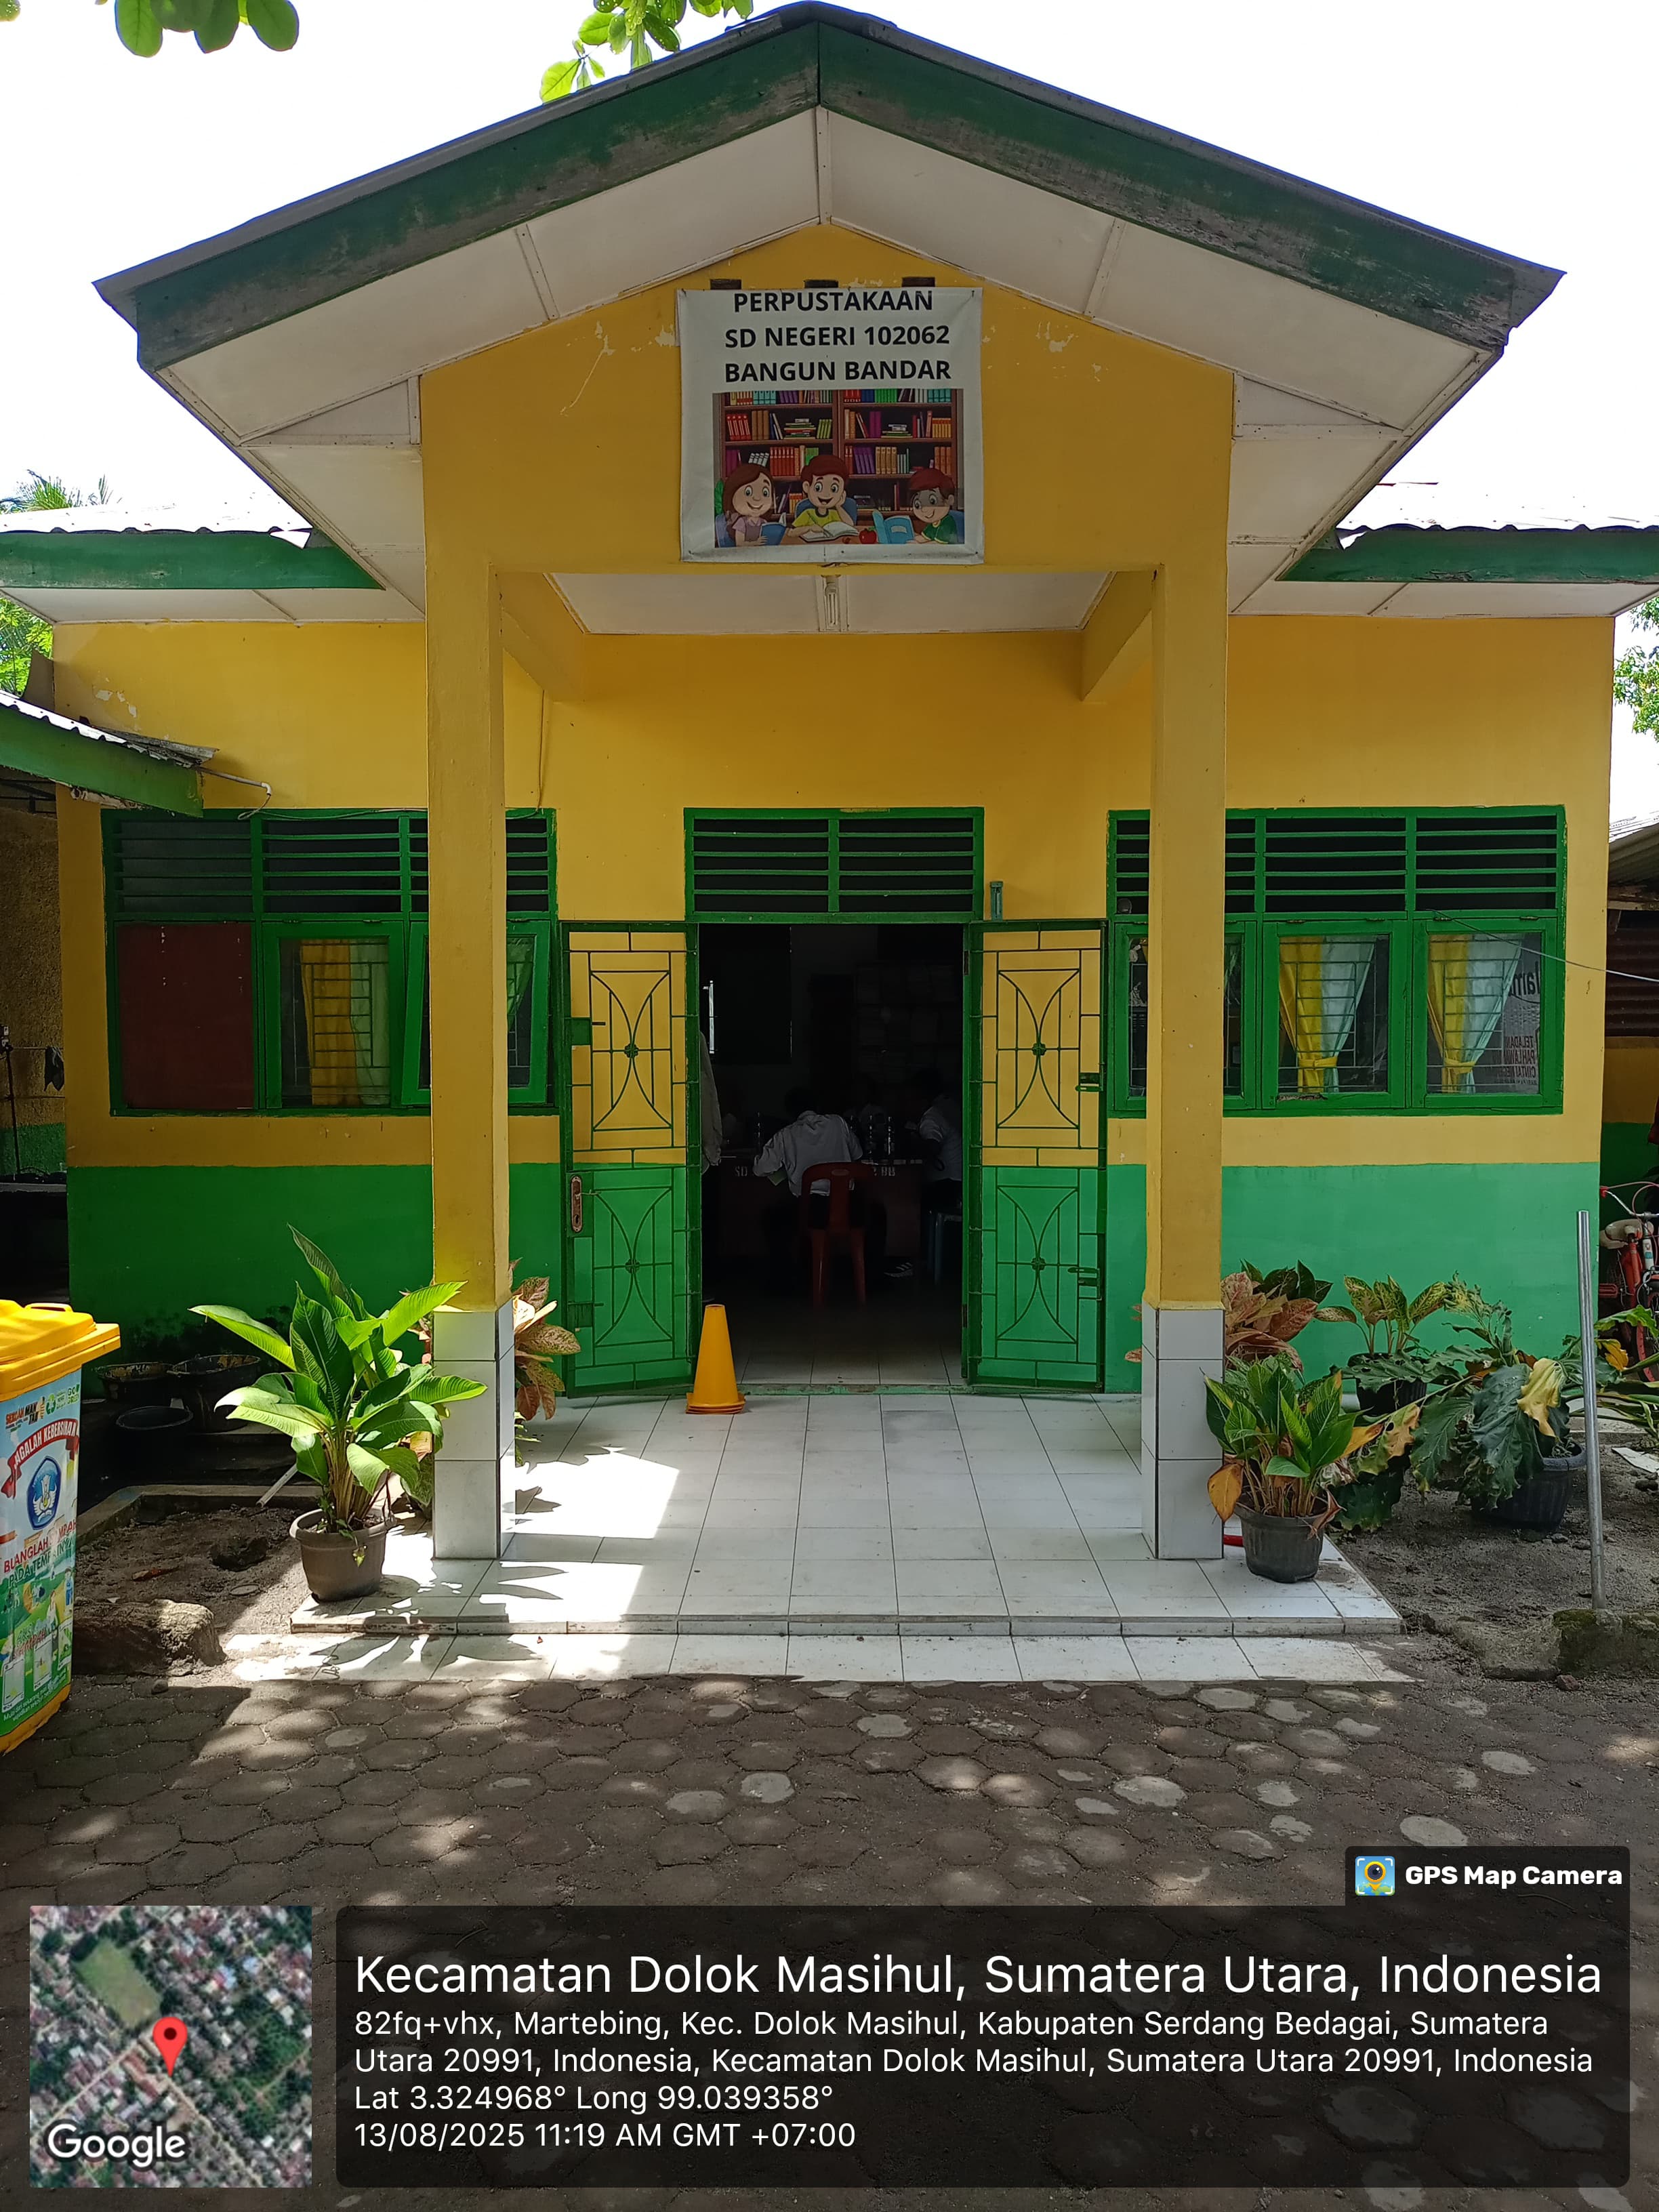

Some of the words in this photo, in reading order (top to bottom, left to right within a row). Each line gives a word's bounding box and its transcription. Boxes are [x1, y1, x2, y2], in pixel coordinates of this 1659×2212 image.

[733, 290, 933, 312] PERPUSTAKAAN
[725, 329, 756, 348] SD
[765, 327, 855, 347] NEGERI
[864, 325, 950, 346] 102062
[725, 362, 836, 383] BANGUN
[844, 360, 951, 380] BANDAR
[4, 1536, 49, 1573] BUANGLAH
[9, 1565, 30, 1586] PADA
[33, 1536, 74, 1572] TEMPTNYA
